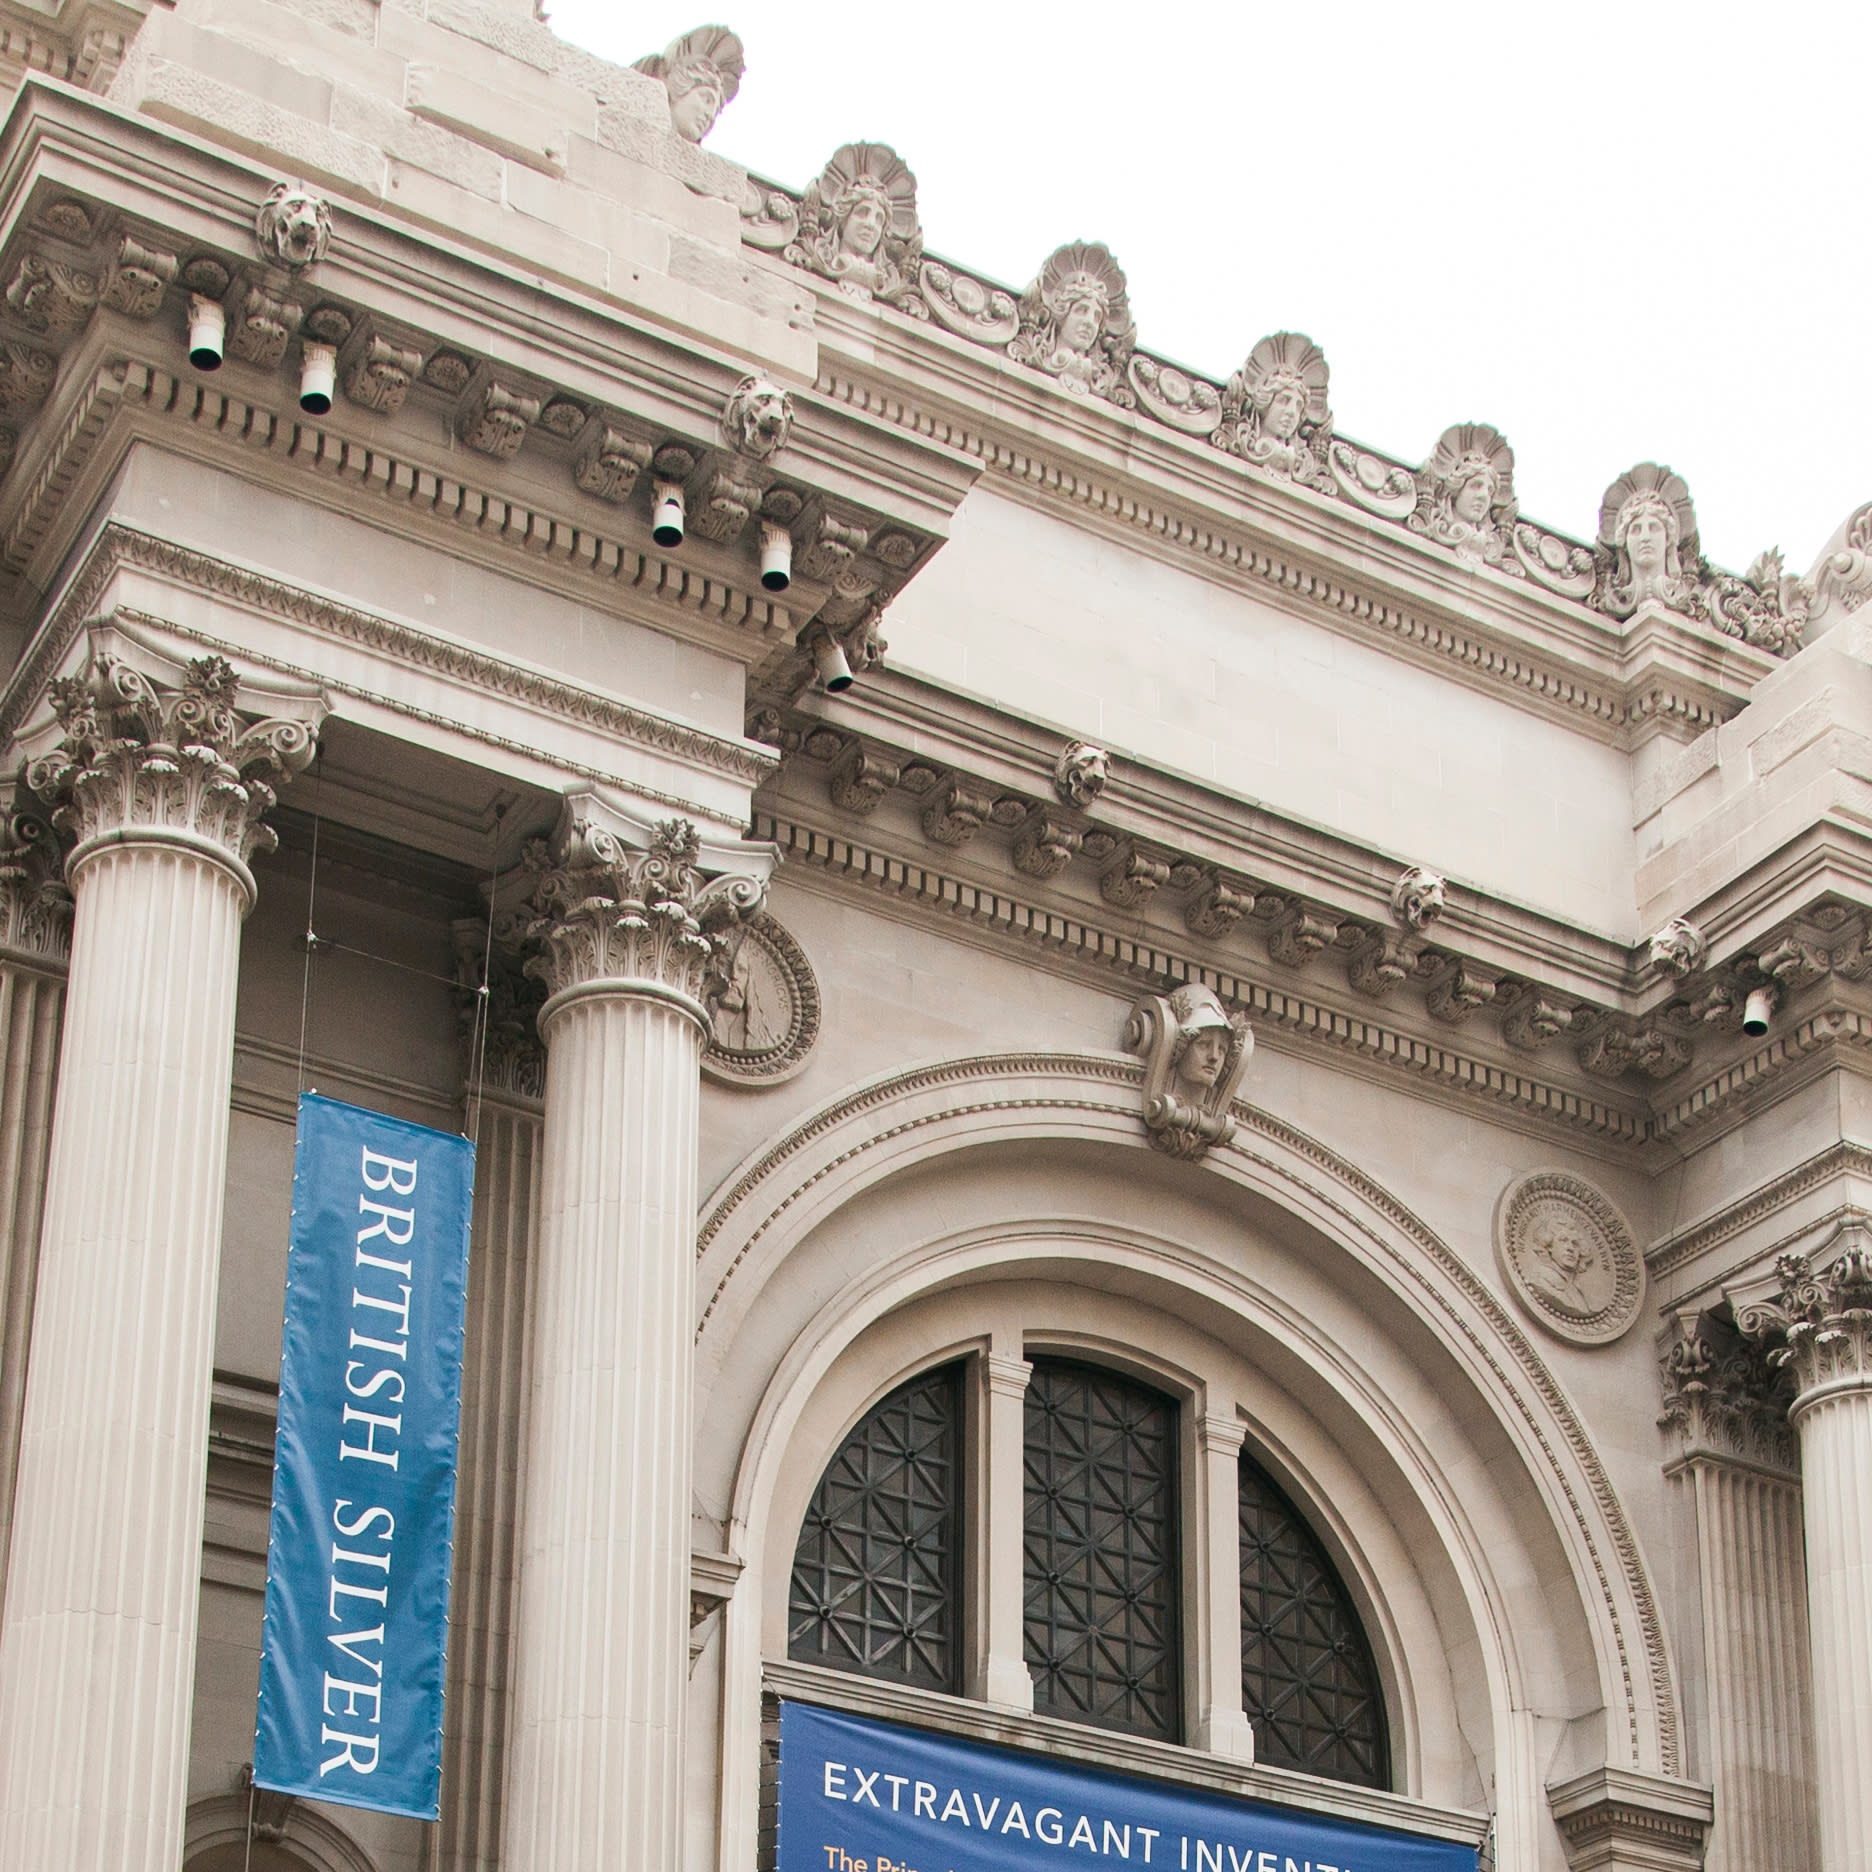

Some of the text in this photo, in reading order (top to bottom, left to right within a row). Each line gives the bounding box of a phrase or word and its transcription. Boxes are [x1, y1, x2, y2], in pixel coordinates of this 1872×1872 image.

[319, 1144, 418, 1778] BRITISH SILVER
[824, 1761, 1160, 1864] EXTRAVAGANT
